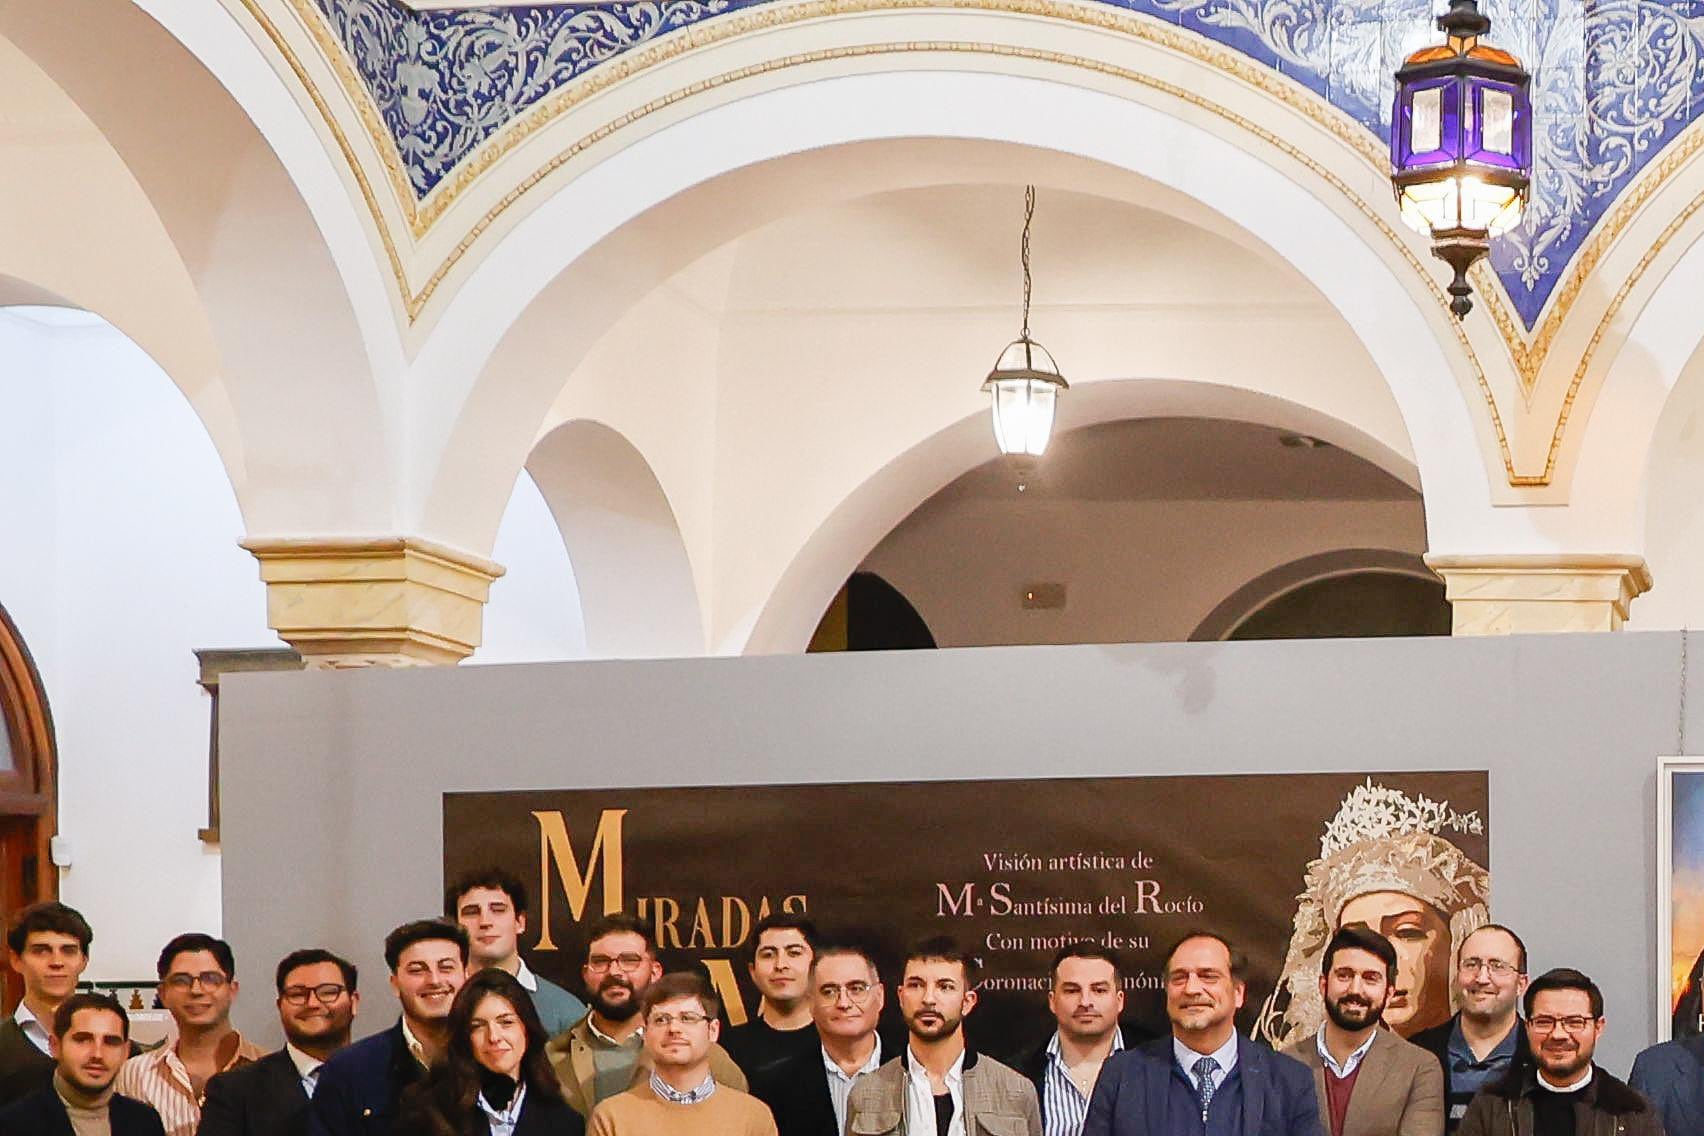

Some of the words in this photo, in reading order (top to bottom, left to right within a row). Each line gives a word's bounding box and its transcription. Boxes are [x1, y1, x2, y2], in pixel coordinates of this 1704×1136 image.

[984, 852, 1042, 872] Visión
[1049, 851, 1126, 871] artística
[1131, 850, 1153, 870] de
[935, 882, 984, 917] Mª
[990, 882, 1093, 917] Santísima
[1098, 895, 1127, 915] del
[1134, 879, 1204, 915] Rocío
[985, 931, 1024, 951] Con
[1101, 930, 1125, 949] de
[1128, 936, 1149, 949] su
